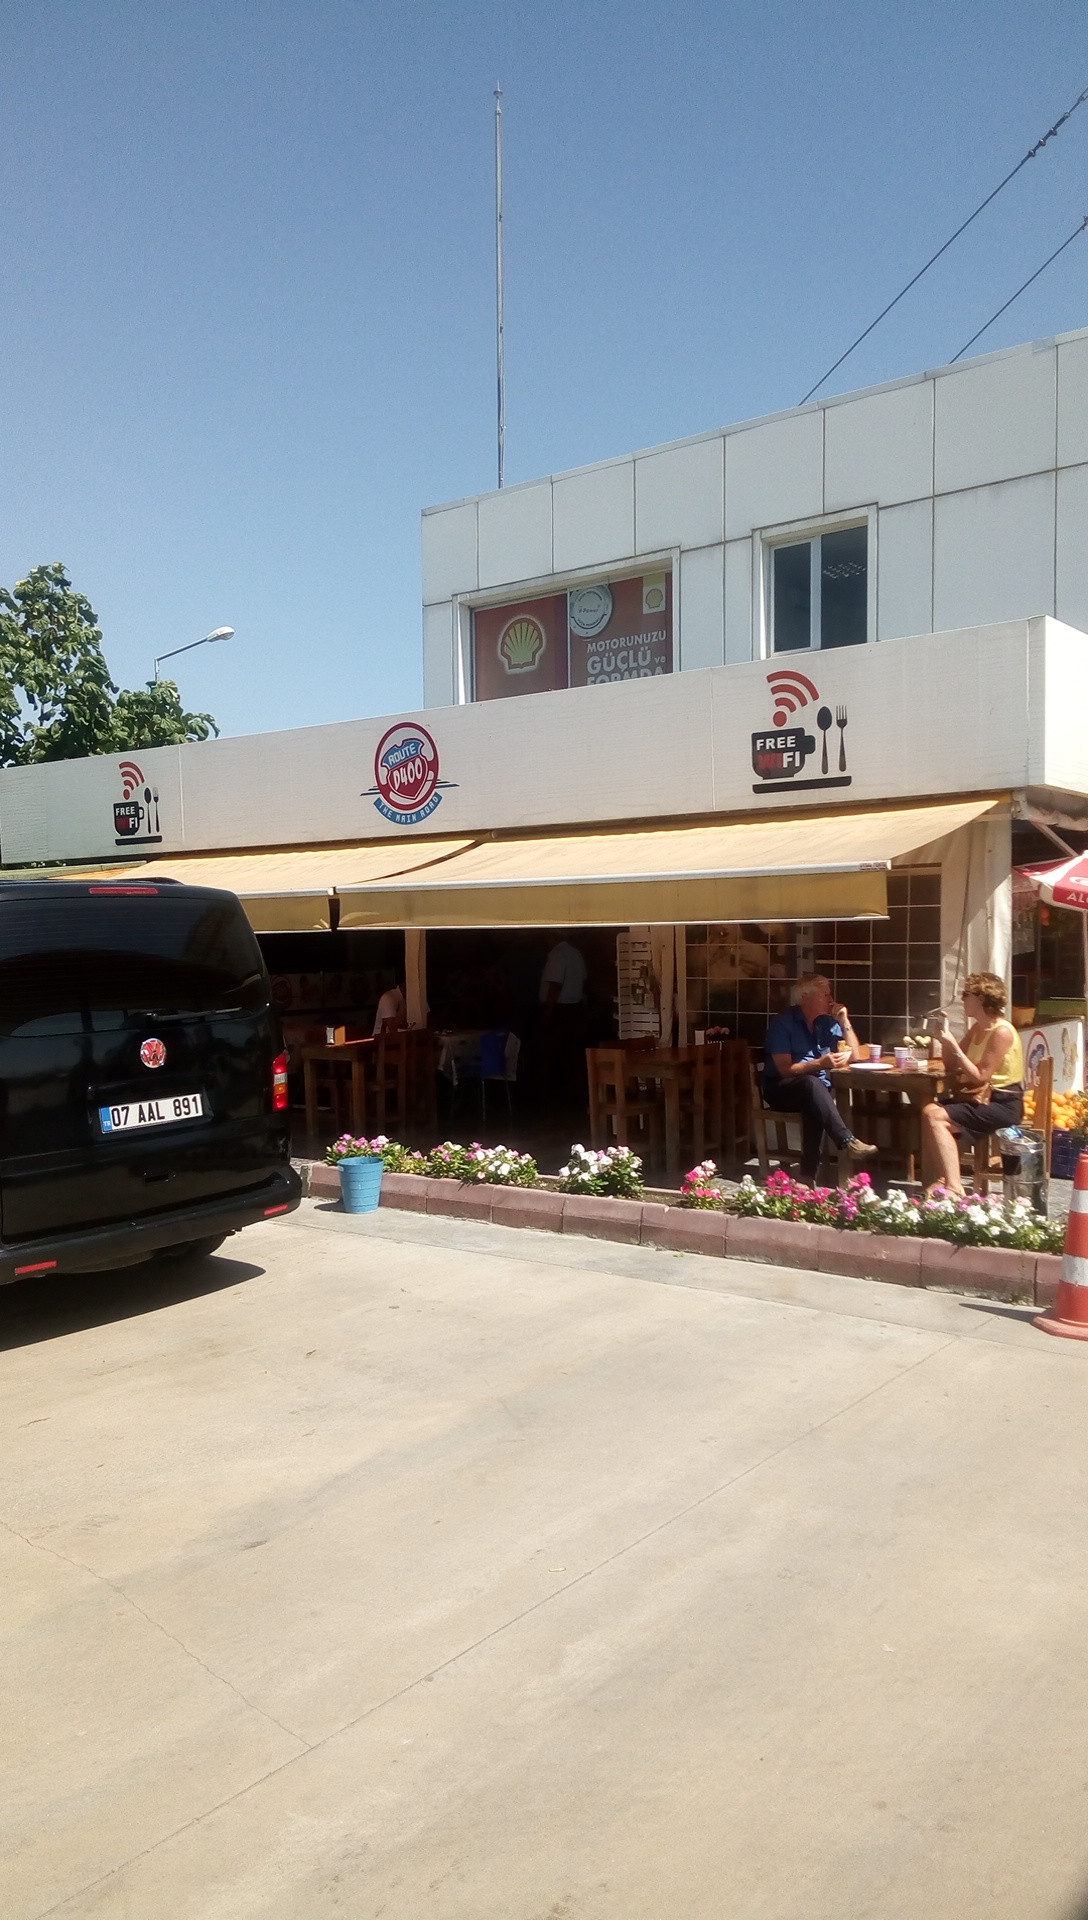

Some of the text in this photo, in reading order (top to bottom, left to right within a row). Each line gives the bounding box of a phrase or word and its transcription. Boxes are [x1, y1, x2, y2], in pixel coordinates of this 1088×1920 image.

[587, 630, 667, 654] MOTORUNUZU
[587, 646, 667, 675] GÜÇLÜ ve
[388, 743, 417, 765] ROUTE
[756, 735, 796, 752] FREE
[393, 757, 423, 790] D400
[116, 806, 136, 816] FREE
[379, 796, 439, 823] THE MAIN ROAD
[1066, 892, 1088, 904] AL
[111, 1105, 130, 1127] 07
[138, 1102, 166, 1123] AAL
[173, 1096, 199, 1117] 891
